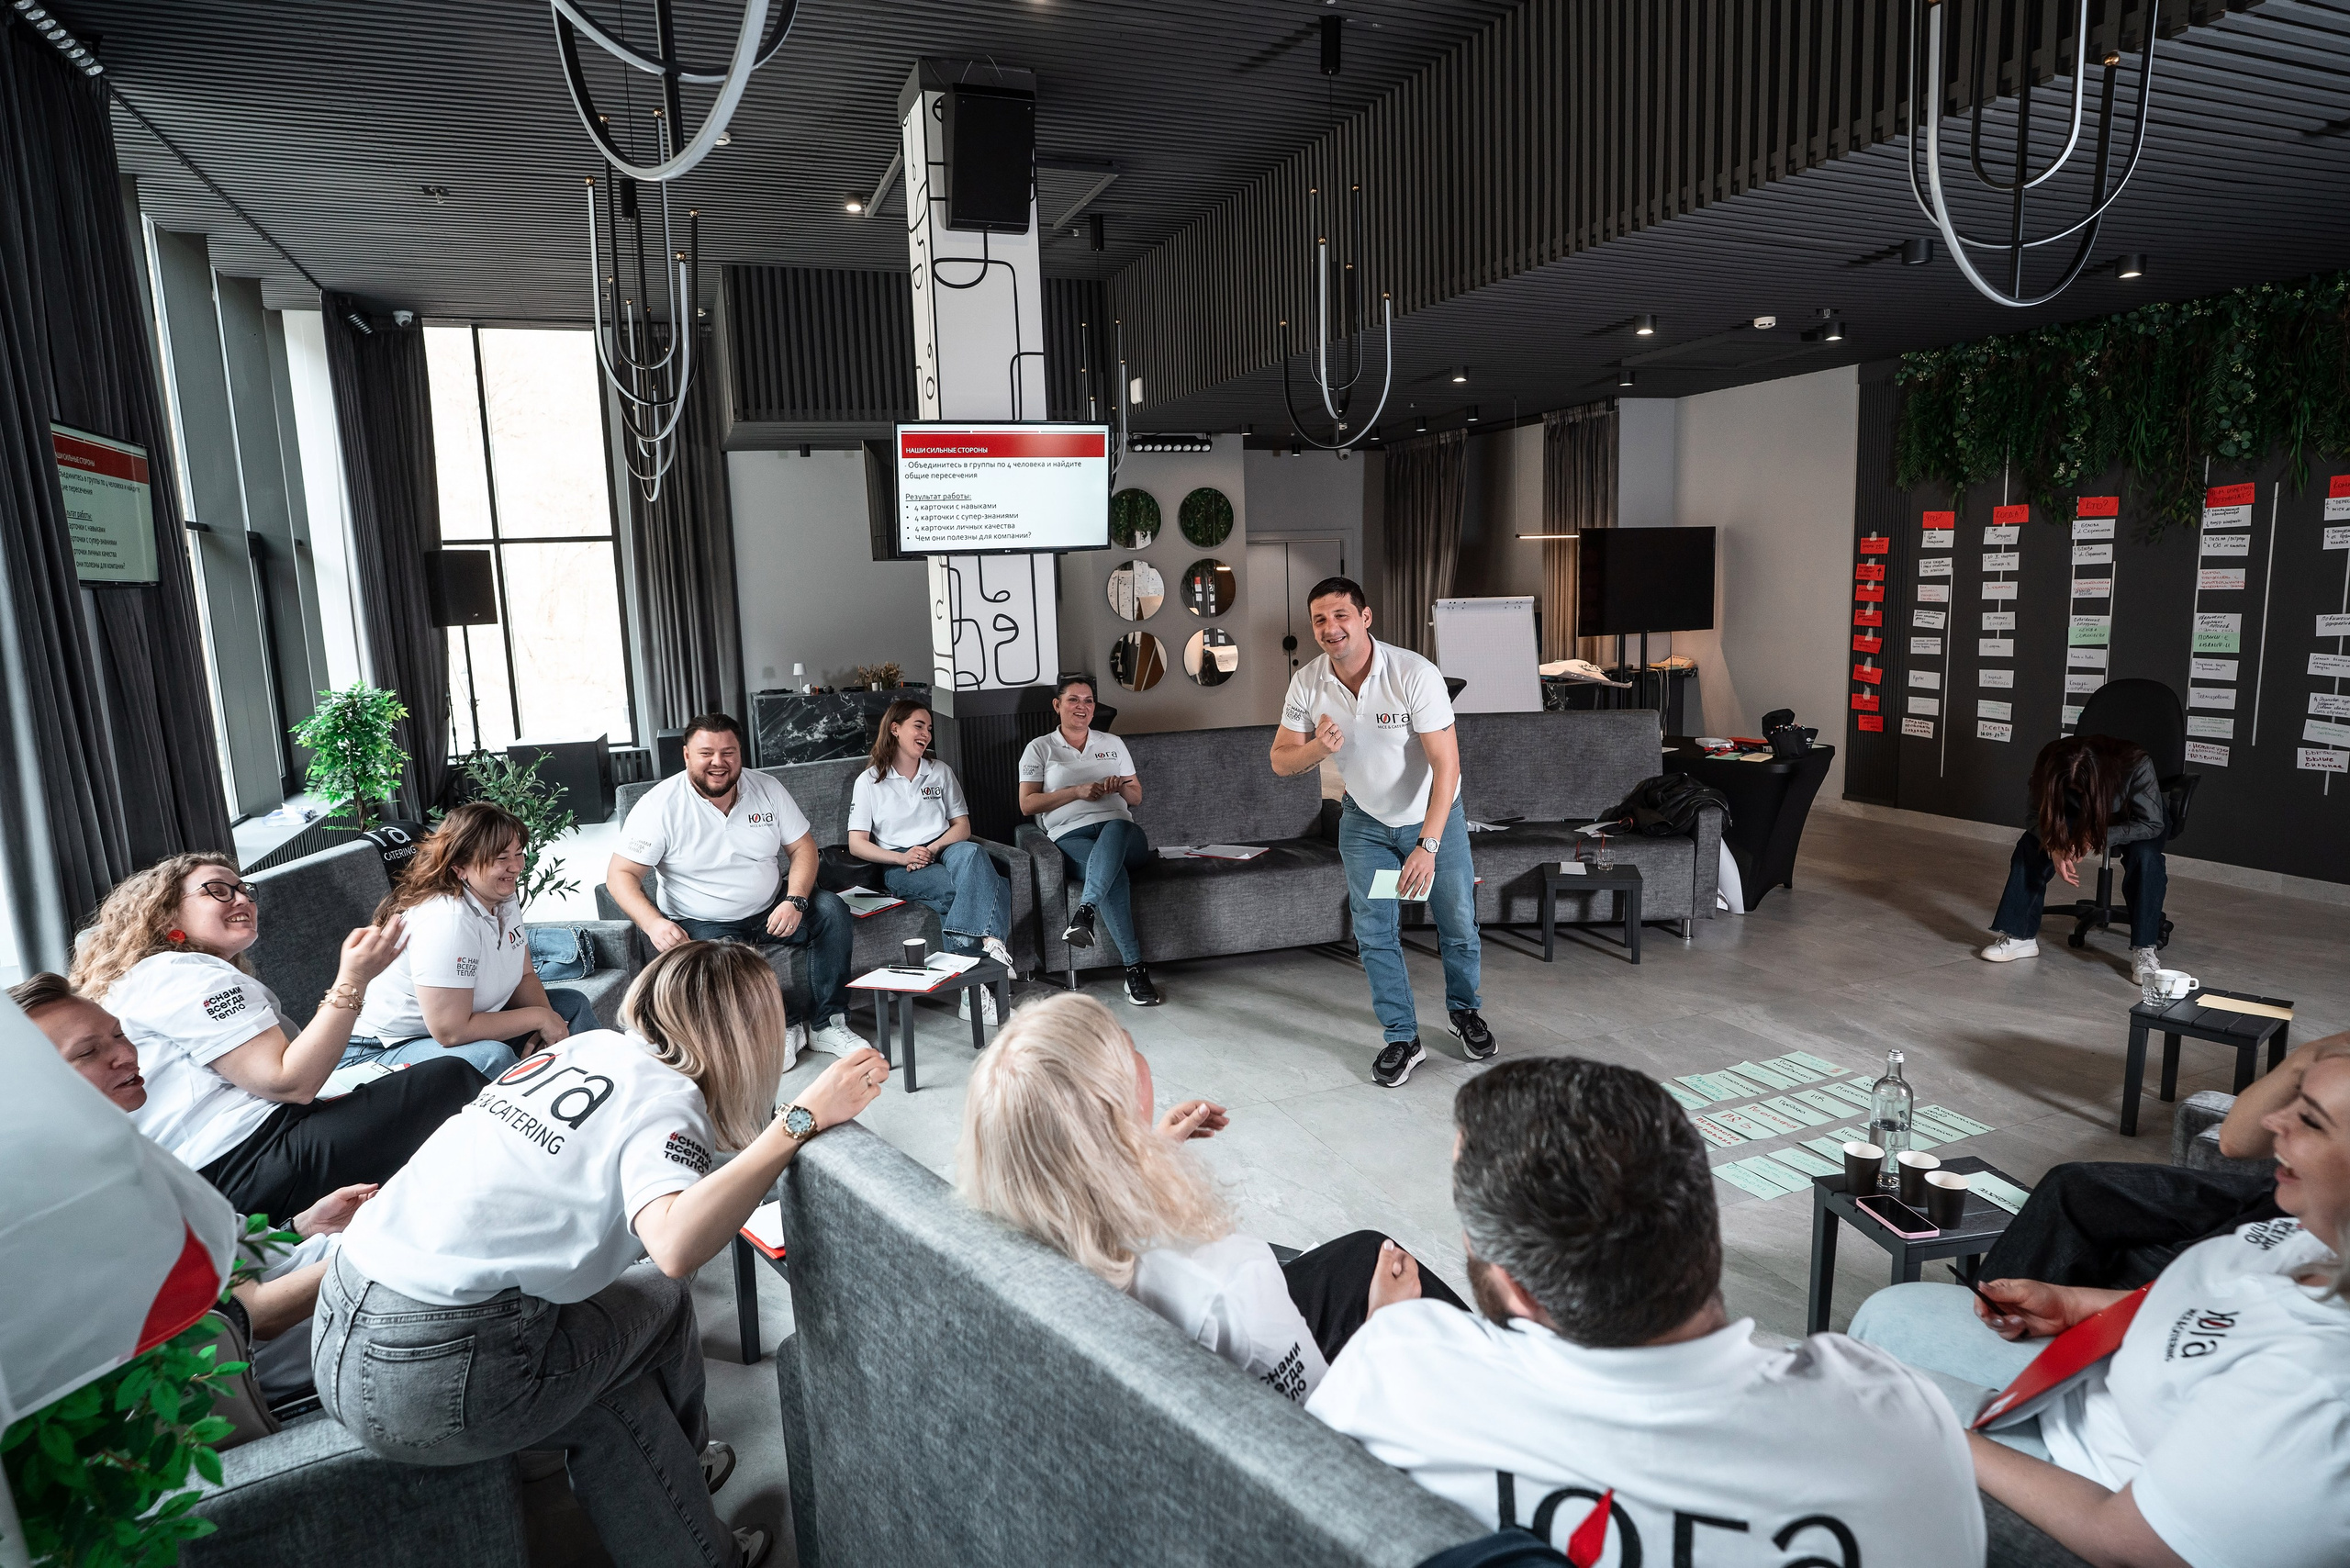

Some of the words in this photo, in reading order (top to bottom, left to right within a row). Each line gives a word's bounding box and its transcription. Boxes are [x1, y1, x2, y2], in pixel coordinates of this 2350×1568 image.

[908, 461, 962, 469] Объединитесь
[59, 468, 84, 481] бъединитесь
[931, 472, 978, 480] пересечения
[905, 493, 941, 501] Результат
[961, 513, 1018, 521] супер-знаниями
[69, 522, 84, 532] арточки
[71, 535, 85, 544] арточки
[993, 532, 1031, 540] компании?
[384, 846, 417, 861] CATERING
[489, 1100, 565, 1155] CATERING
[1274, 1361, 1304, 1394] егда
